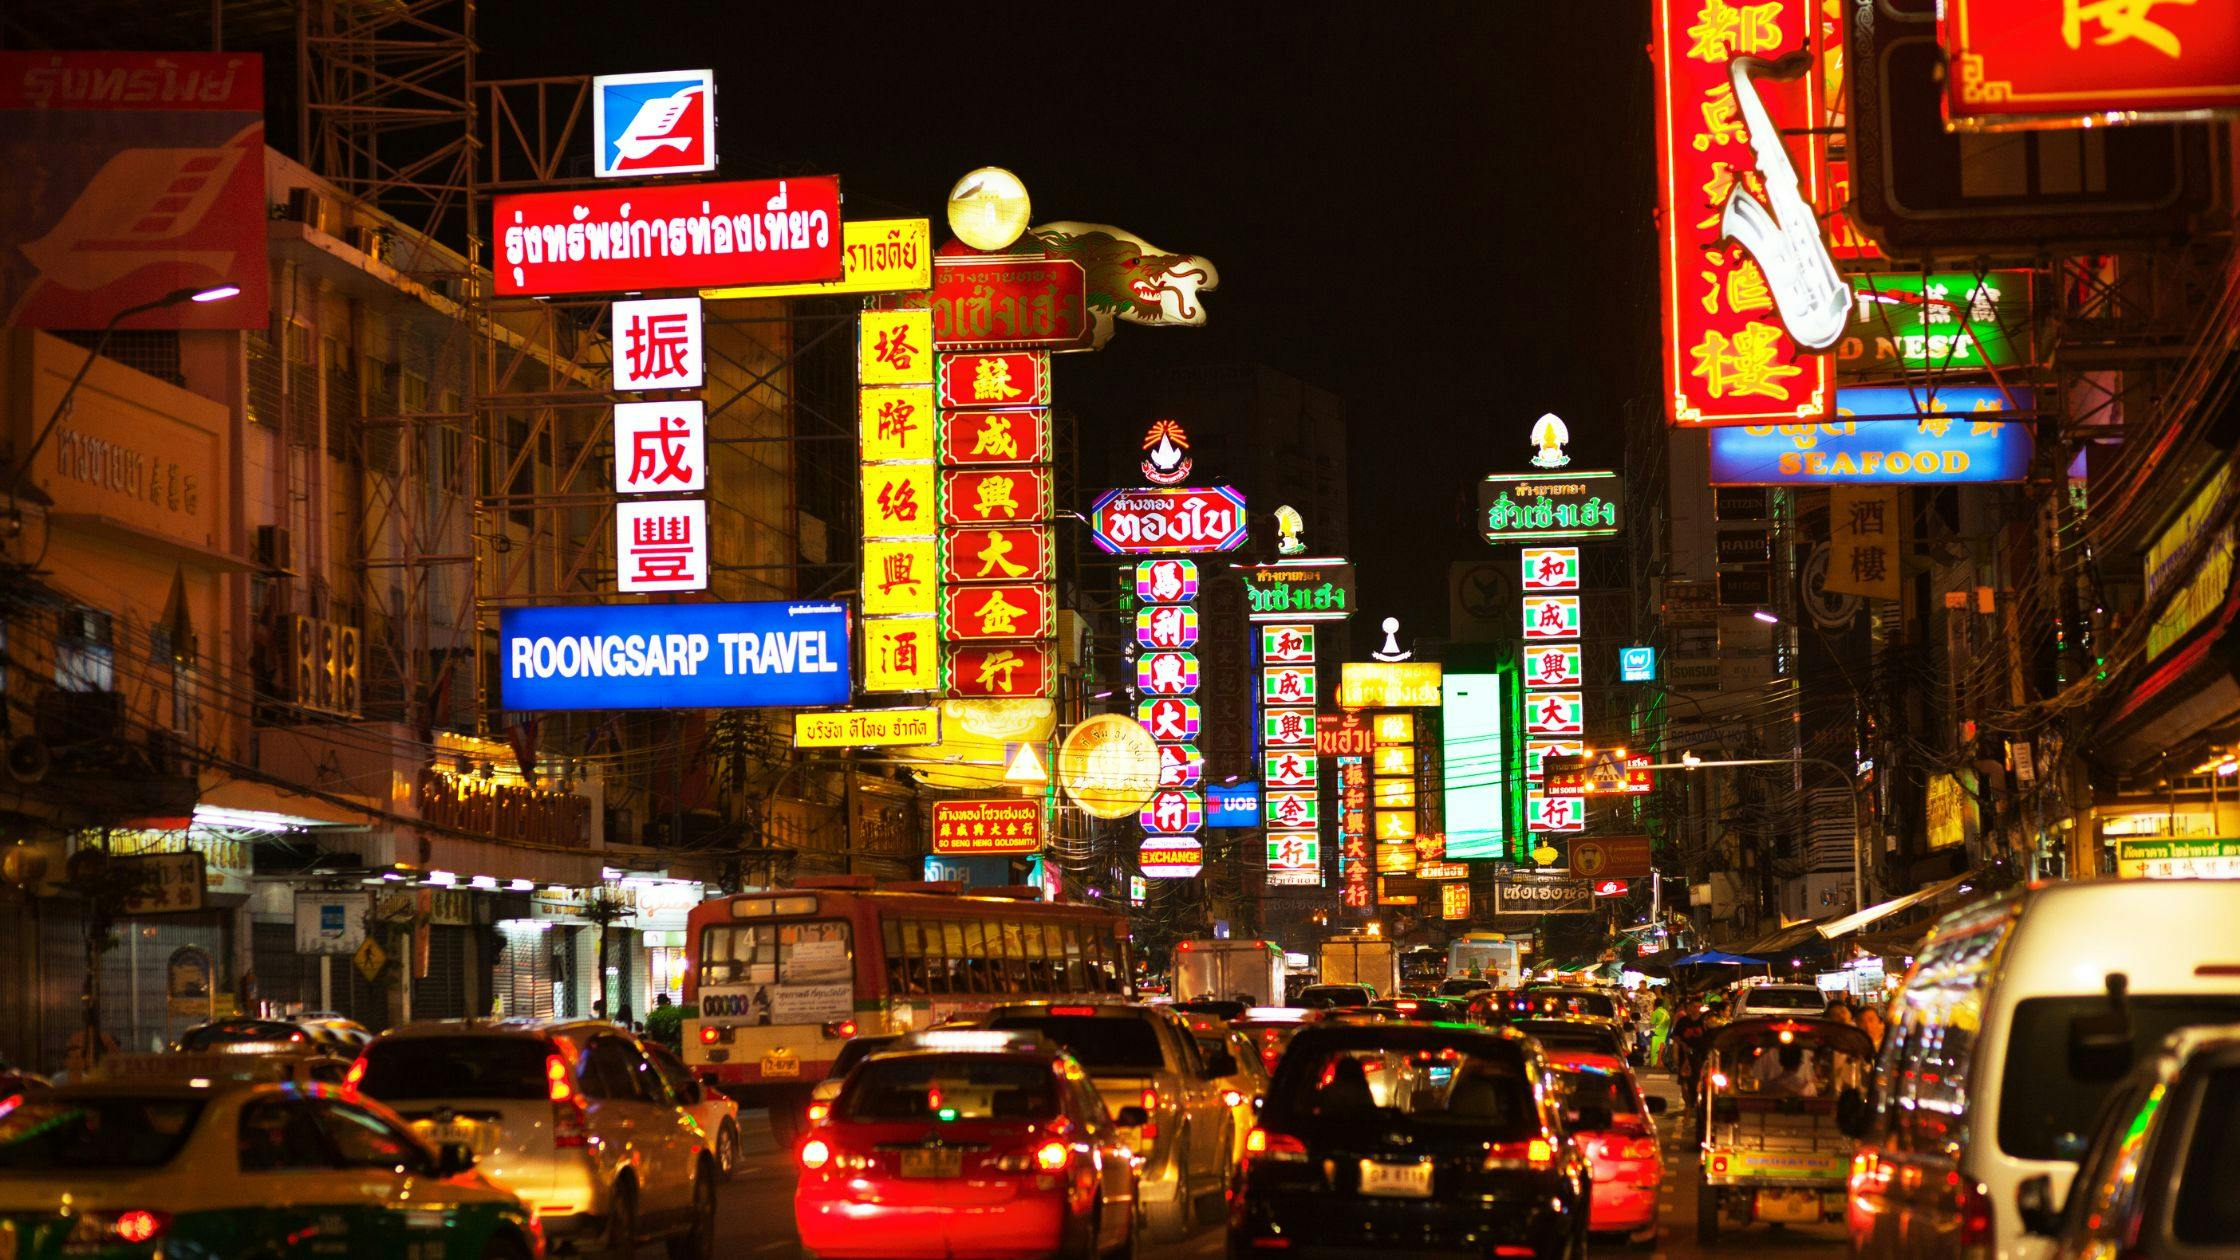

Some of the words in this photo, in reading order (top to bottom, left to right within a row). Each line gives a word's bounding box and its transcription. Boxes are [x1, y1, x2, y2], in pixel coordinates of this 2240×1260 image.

[505, 181, 829, 287] รุ่งทรัพย์การท่องเที่ยว
[1875, 334, 1975, 360] NEST
[625, 313, 695, 583] 振成豐
[1779, 451, 1971, 475] SEAFOOD
[1113, 493, 1175, 511] ห้างทอง
[1109, 497, 1232, 543] ทองใบ
[1722, 539, 1766, 551] RADO
[512, 633, 710, 679] ROONGSARP
[718, 631, 838, 676] TRAVEL
[807, 720, 843, 740] บริษัท
[893, 717, 927, 738] จำกัด
[1277, 632, 1305, 865] 和成興大金行
[1224, 797, 1258, 812] UOB
[938, 839, 949, 848] SO
[951, 839, 971, 848] SENG
[972, 839, 993, 847] HENG
[994, 838, 1036, 847] GOLDSMITH
[1141, 850, 1201, 864] EXCHANGE
